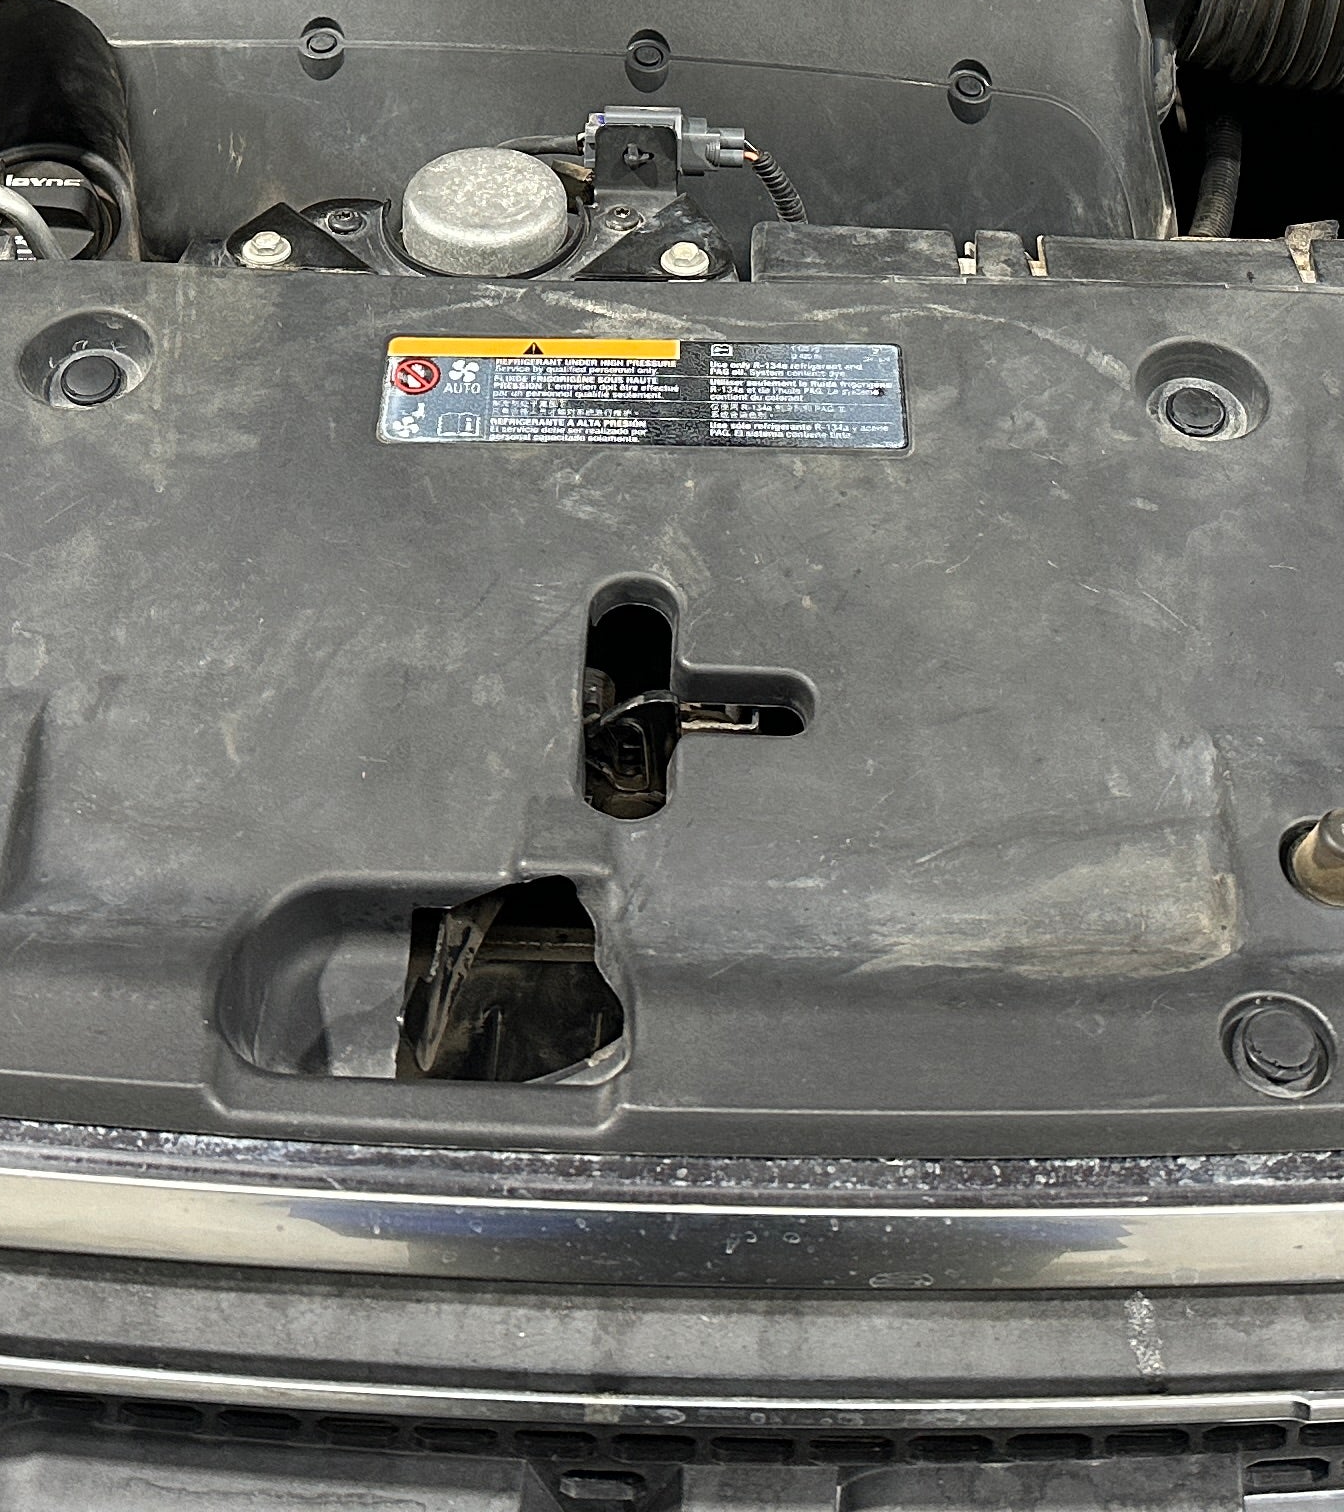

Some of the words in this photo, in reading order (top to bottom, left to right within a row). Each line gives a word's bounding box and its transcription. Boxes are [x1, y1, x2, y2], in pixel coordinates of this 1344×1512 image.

[565, 359, 597, 367] UNDER
[626, 360, 677, 368] PRESSURE
[710, 361, 728, 369] Use
[730, 362, 750, 371] only
[753, 362, 787, 370] R-134a
[443, 383, 481, 394] AUTO
[577, 419, 601, 427] ALTA
